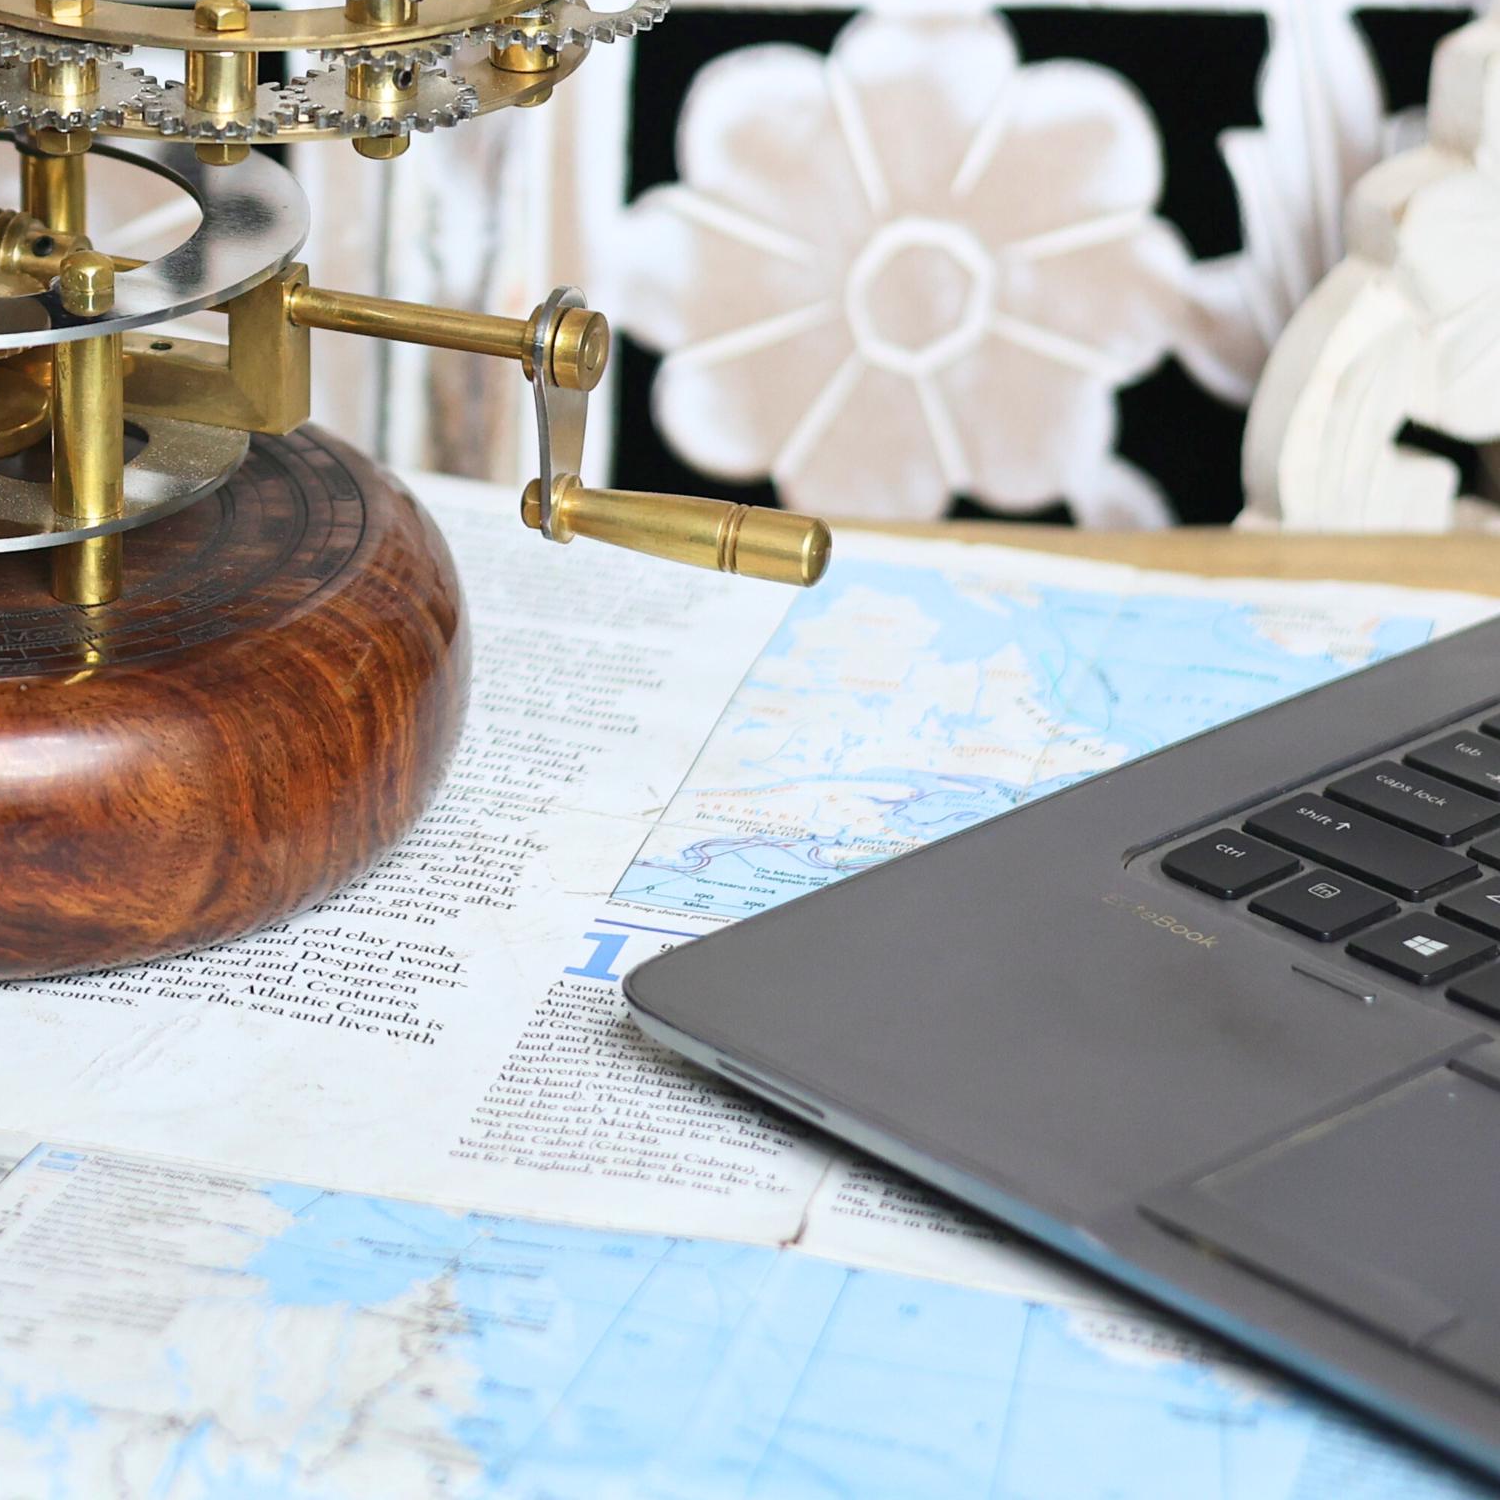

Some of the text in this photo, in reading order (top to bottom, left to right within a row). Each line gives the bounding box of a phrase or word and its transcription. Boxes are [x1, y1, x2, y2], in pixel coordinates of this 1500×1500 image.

[490, 738, 581, 761] England
[1454, 742, 1483, 757] tab
[492, 775, 545, 789] their
[1375, 772, 1447, 807] caps lock
[445, 793, 559, 815] like speak-
[478, 808, 528, 822] New
[1295, 806, 1333, 826] shift
[514, 838, 549, 852] the
[1215, 843, 1246, 858] ctrl
[420, 863, 512, 883] Isolation
[455, 854, 525, 871] where
[374, 883, 518, 910] masters after
[427, 875, 515, 897] Scottish
[748, 887, 776, 895] 1524
[1316, 884, 1333, 897] fn
[390, 898, 461, 919] giving
[606, 899, 631, 909] Each
[633, 905, 655, 915] map
[657, 908, 689, 918] shows
[683, 901, 710, 910] Miles
[742, 900, 766, 908] 200
[415, 915, 436, 925] in
[302, 927, 455, 958] red clay roads
[256, 936, 468, 974] and covered wood-
[562, 931, 630, 982] 1
[255, 961, 418, 995] and evergreen
[300, 950, 468, 989] Despite gener-
[199, 966, 420, 1011] forested. Centuries
[547, 988, 616, 1007] brought
[570, 984, 619, 996] quirk
[108, 981, 436, 1046] that face the sea and live with
[151, 975, 445, 1031] ashore, Atlantic Canada is
[489, 1083, 586, 1102] (vine land).
[497, 1073, 582, 1088] Markland
[585, 1080, 662, 1099] (wooded
[469, 1117, 501, 1127] was
[507, 1122, 590, 1136] recorded
[593, 1129, 609, 1138] in
[475, 1106, 781, 1156] expedition to Markland for timber
[483, 1094, 795, 1148] until the early 11th century, but an
